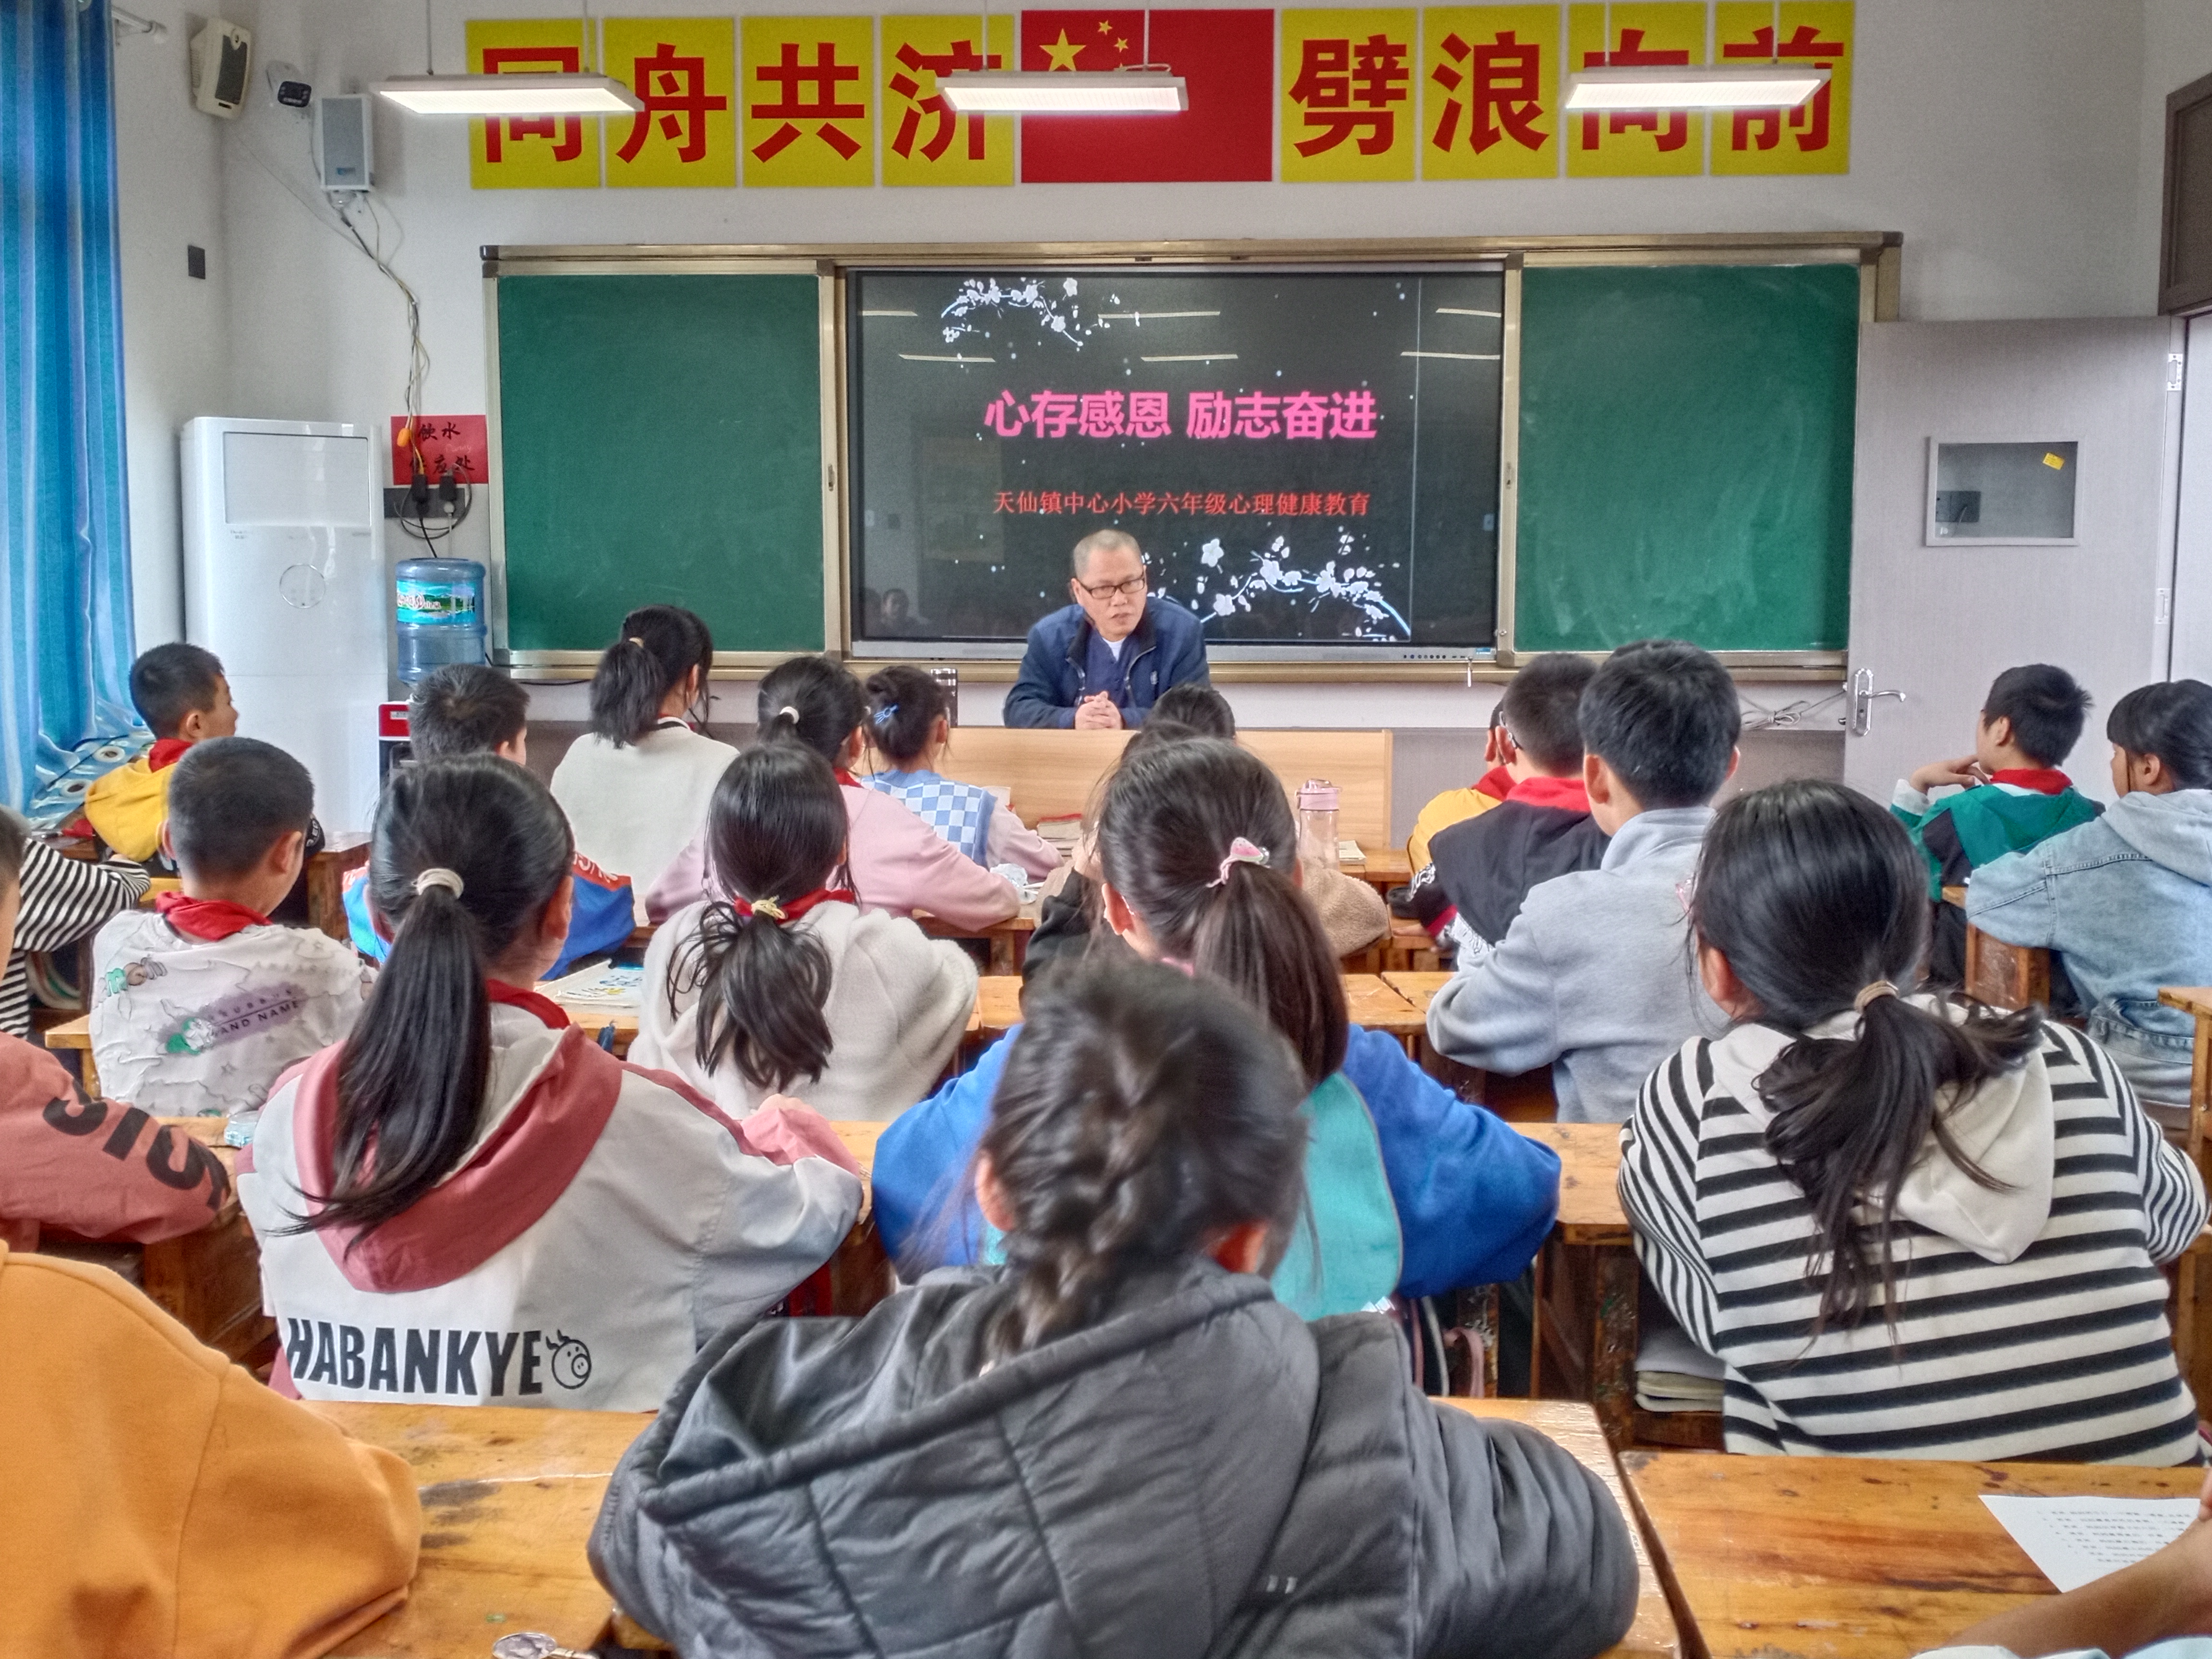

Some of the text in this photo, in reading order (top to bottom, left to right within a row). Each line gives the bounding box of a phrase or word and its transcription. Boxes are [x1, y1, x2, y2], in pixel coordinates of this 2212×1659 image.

[482, 25, 1844, 163] 同舟共济 劈浪向前
[984, 390, 1377, 439] 心存感恩 励志奋进
[993, 491, 1370, 517] 天仙镇中心小学六年级心理健康教育
[212, 1019, 250, 1036] AND
[257, 1000, 299, 1022] NAME
[287, 1317, 542, 1397] HABANKYE
